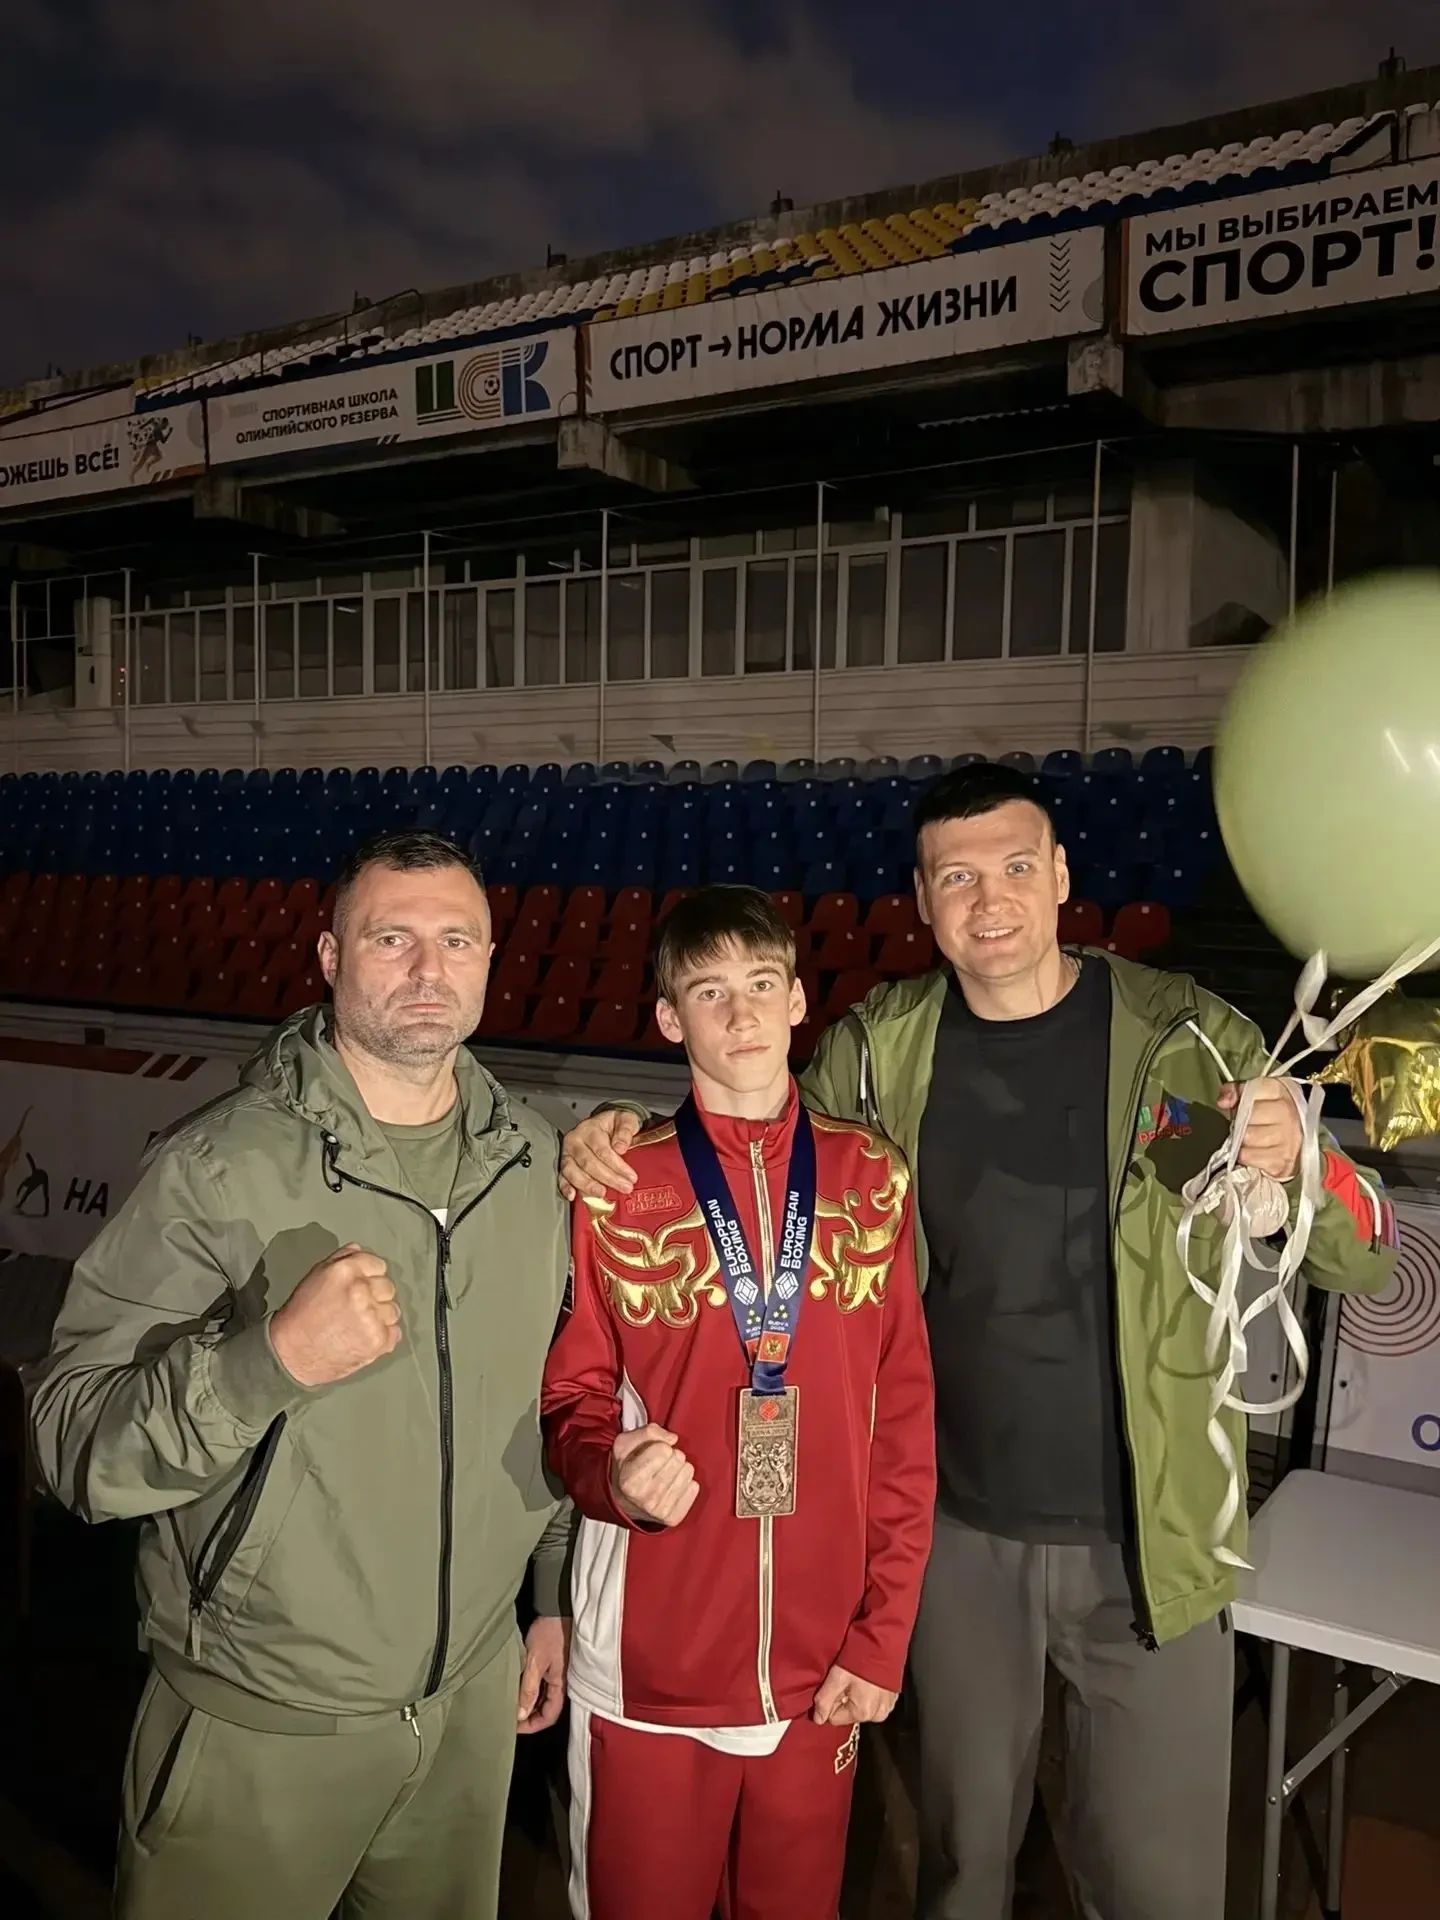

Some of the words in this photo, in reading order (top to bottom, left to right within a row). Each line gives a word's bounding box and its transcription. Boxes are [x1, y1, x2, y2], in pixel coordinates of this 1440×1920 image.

[1146, 223, 1206, 256] МЫ
[1218, 180, 1439, 243] ВЫБИРАЕМ
[1139, 214, 1437, 313] СПОРТ!
[610, 335, 702, 381] СПОРТ
[737, 305, 864, 360] НОРМА
[876, 275, 1018, 337] ЖИЗНИ
[235, 415, 337, 445] ОЛИМПИЙСКОГО
[340, 407, 399, 427] РЕЗЕРВА
[262, 399, 344, 423] СПОРТИВНАЯ
[348, 388, 399, 408] ШКОЛА
[75, 444, 120, 475] ВСЁ!
[706, 1199, 740, 1277] EUROPEAN
[728, 1219, 751, 1274] BOXING
[780, 1190, 800, 1269] EUROPEAN
[791, 1216, 809, 1270] BOXING
